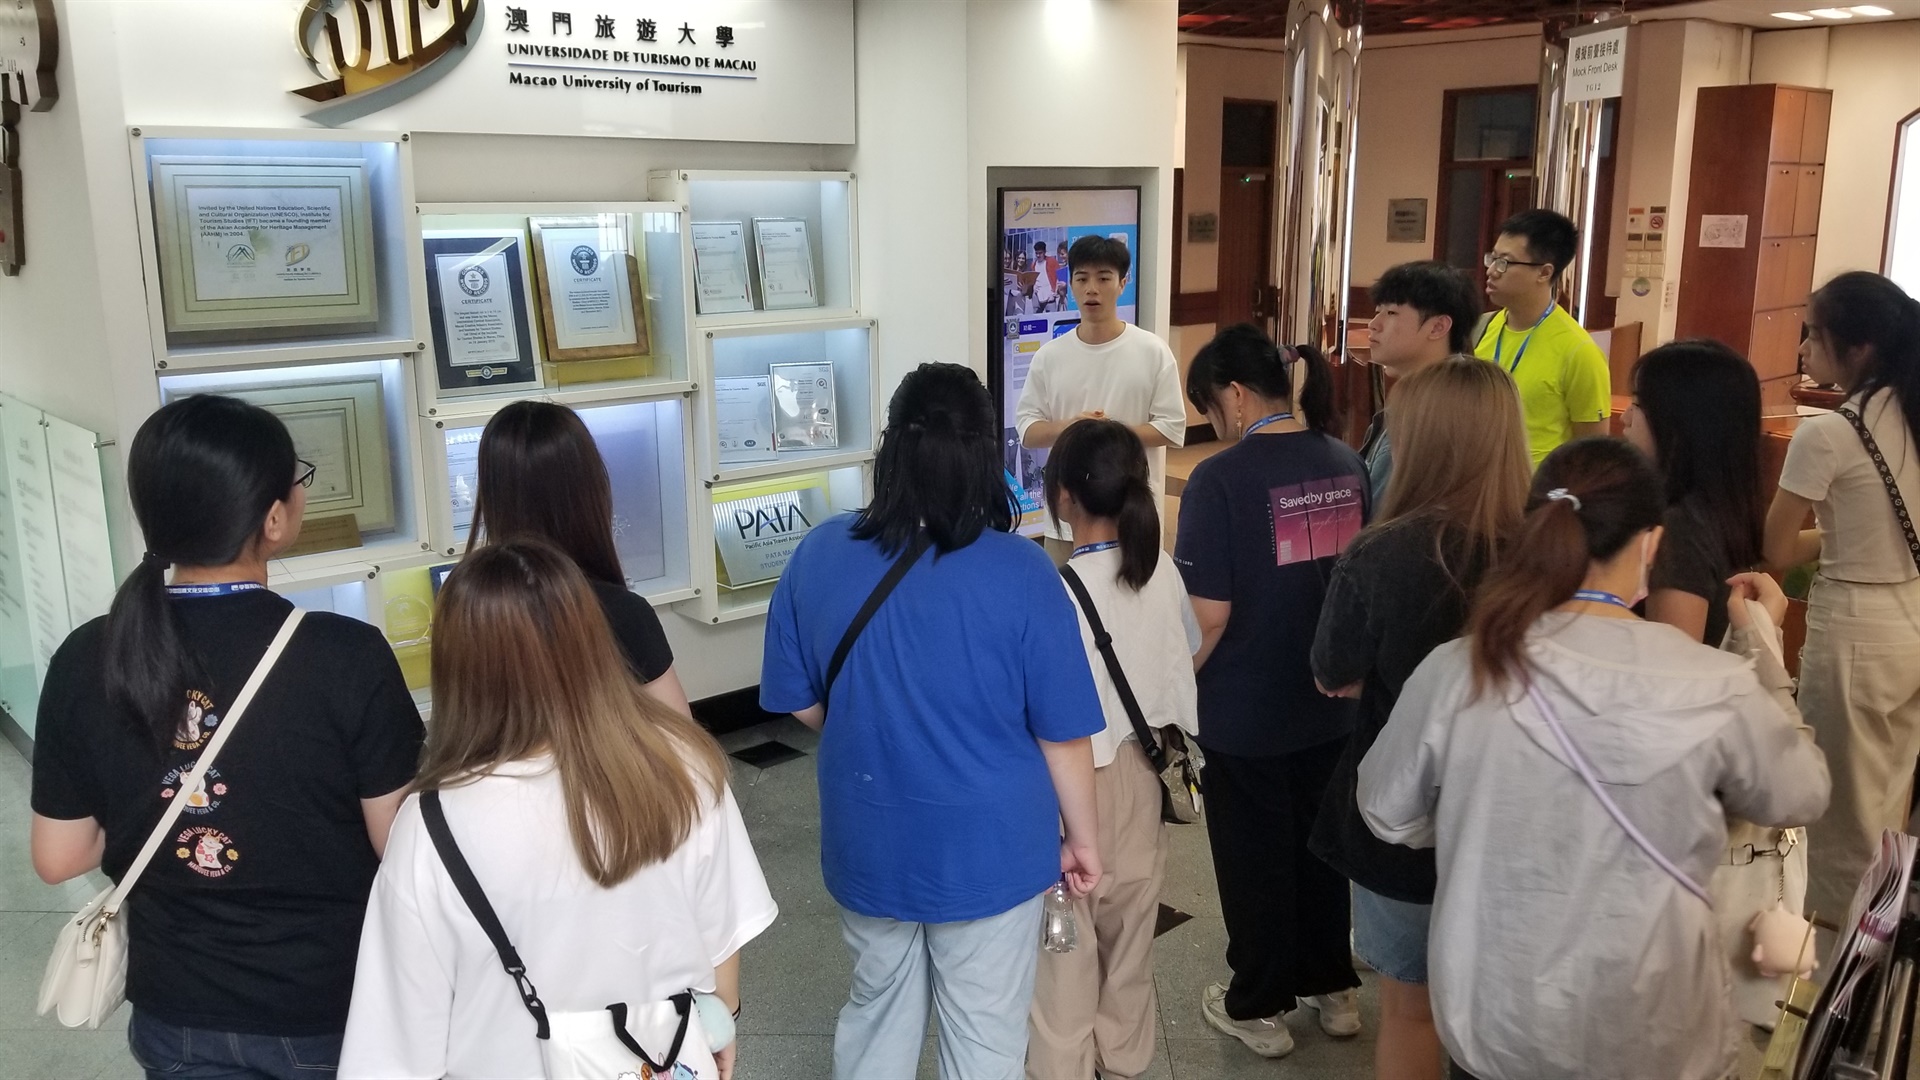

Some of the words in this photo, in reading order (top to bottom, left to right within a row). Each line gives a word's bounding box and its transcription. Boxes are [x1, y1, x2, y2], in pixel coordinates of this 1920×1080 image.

[505, 5, 735, 48] 澳門旅遊大學
[507, 43, 609, 62] UNIVERSIDADE
[613, 50, 630, 63] DE
[633, 52, 691, 67] TURISMO
[695, 56, 711, 69] DE
[714, 58, 757, 72] MACAU
[1572, 66, 1587, 77] Mock
[1588, 64, 1603, 75] Front
[1603, 61, 1618, 73] Desk
[509, 71, 558, 87] Macao
[563, 75, 632, 94] University
[636, 78, 651, 92] of
[652, 79, 703, 95] Tourism
[233, 211, 269, 219] Organization
[1030, 489, 1041, 499] the
[1280, 493, 1323, 509] Savedby
[1325, 488, 1352, 503] grace
[744, 541, 762, 550] Pacific
[762, 540, 774, 548] Asia
[773, 537, 789, 545] Travel
[765, 551, 782, 559] PATA
[760, 559, 788, 569] STUDENT
[201, 695, 214, 710] CAT
[161, 768, 181, 785] VEGA
[179, 761, 196, 772] LUC
[196, 807, 209, 815] VEGA
[177, 828, 195, 843] VEGA
[191, 826, 219, 836] LUCKY
[218, 832, 233, 845] CAT
[187, 860, 210, 877] MARQUEE
[209, 870, 221, 878] VEGA
[223, 864, 233, 873] CO.
